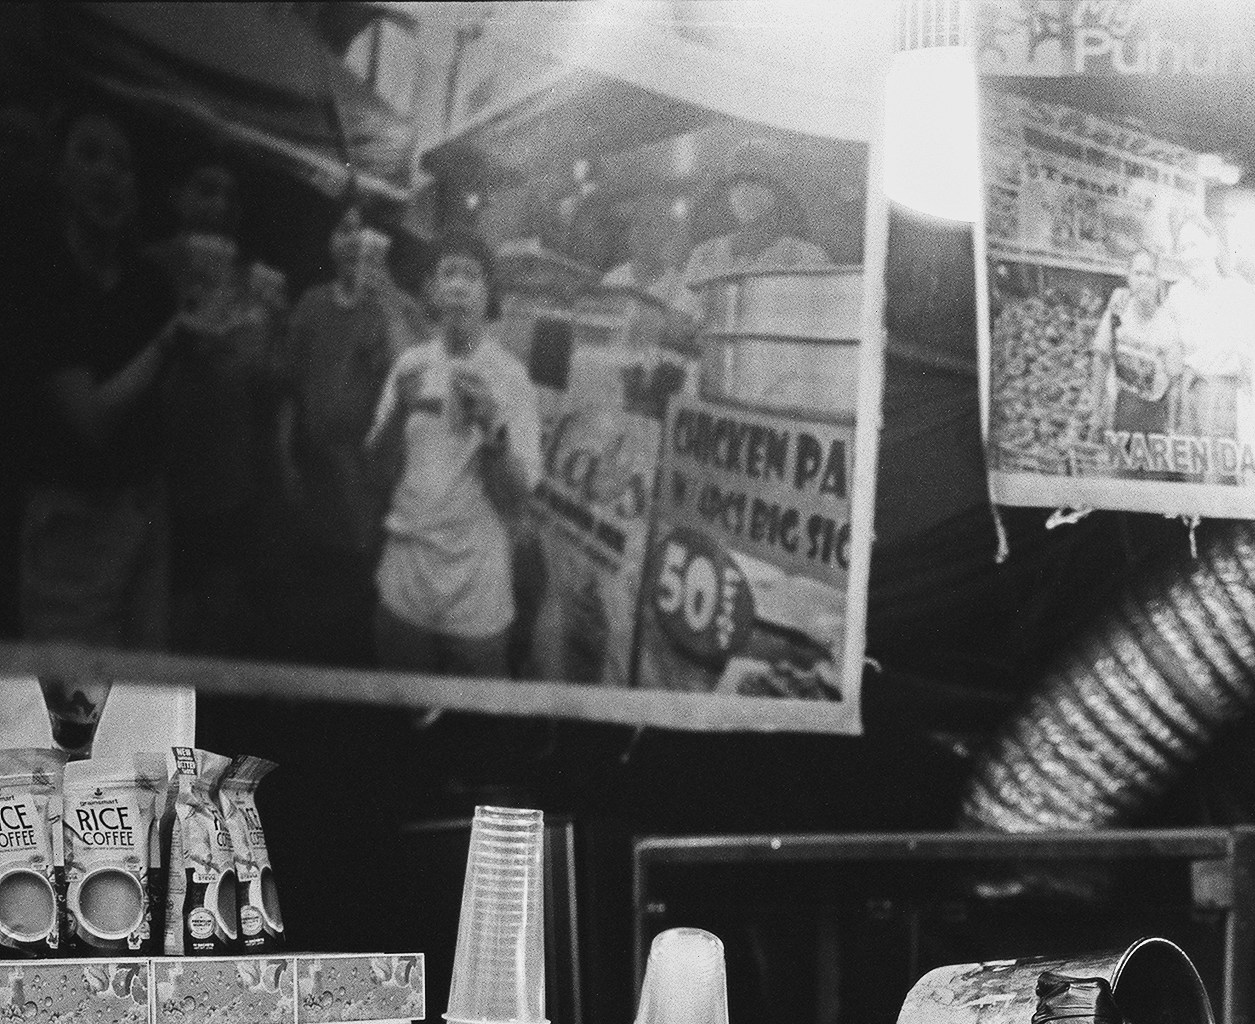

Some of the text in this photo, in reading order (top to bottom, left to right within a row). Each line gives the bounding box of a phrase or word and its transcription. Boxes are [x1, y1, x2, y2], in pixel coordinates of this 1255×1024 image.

[1103, 431, 1209, 475] KAREN
[656, 540, 718, 631] 50
[0, 804, 33, 830] CE
[76, 806, 133, 830] RICE
[0, 830, 37, 847] OFFEE
[83, 831, 134, 846] COFFEE
